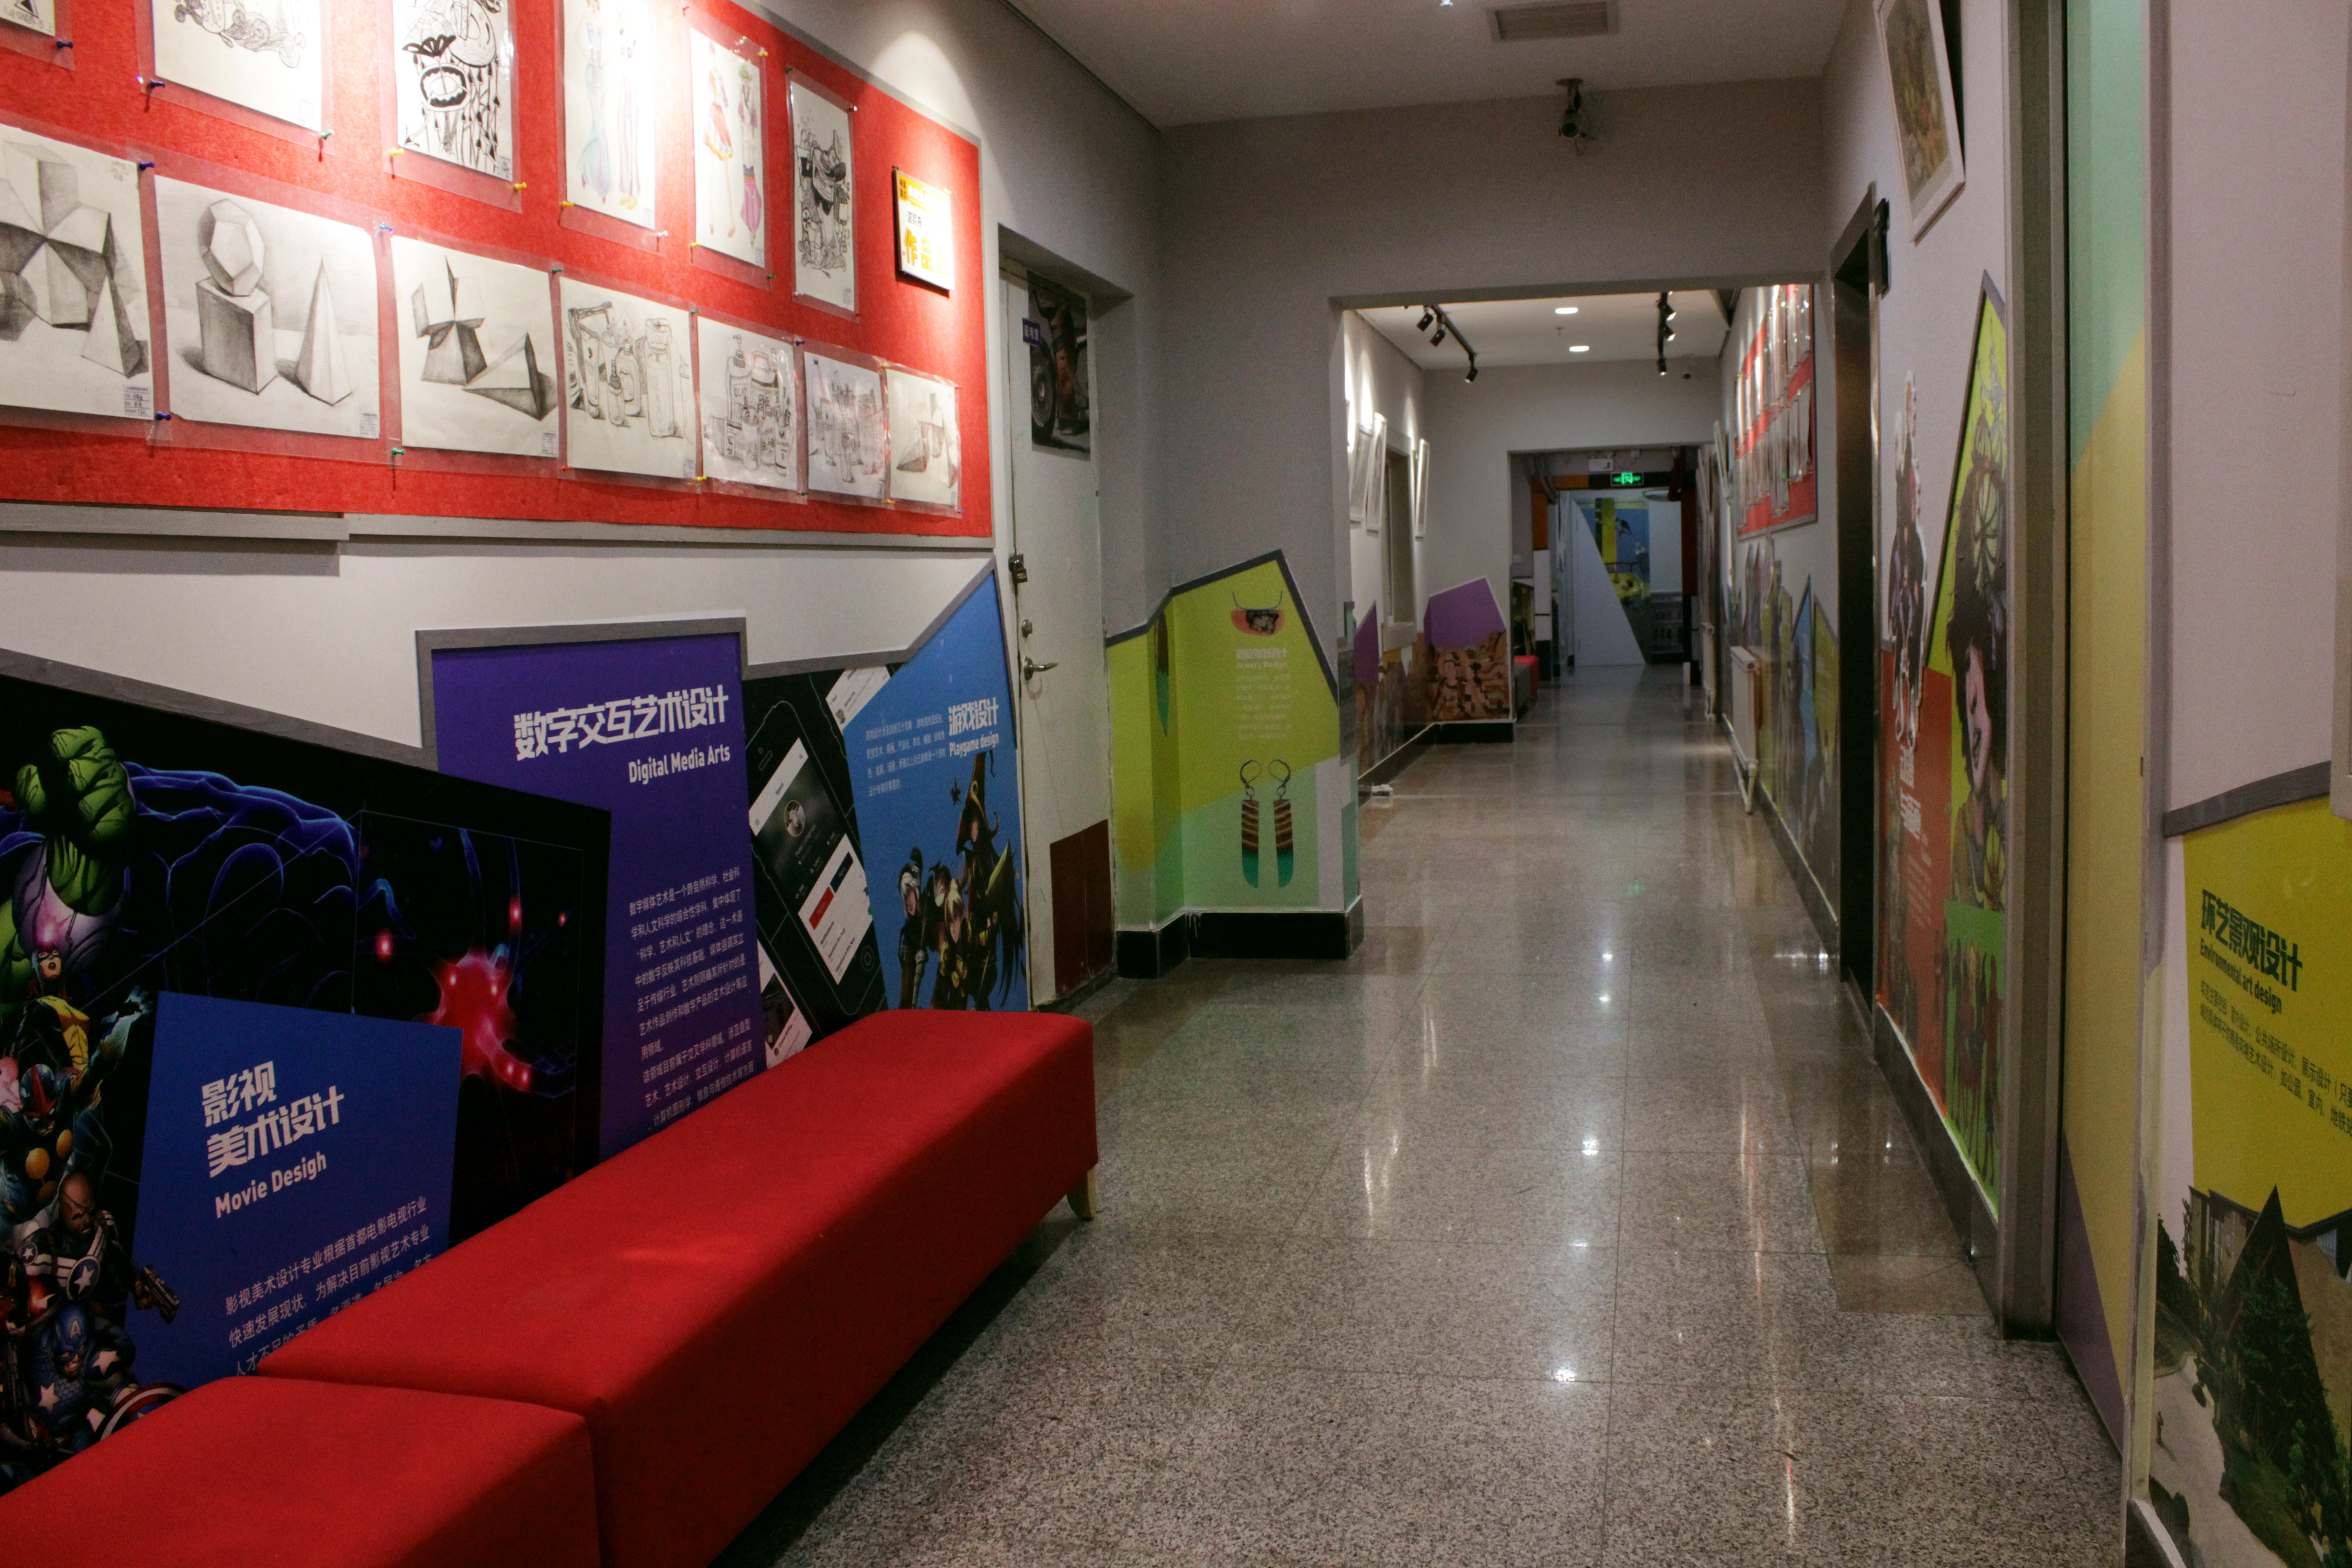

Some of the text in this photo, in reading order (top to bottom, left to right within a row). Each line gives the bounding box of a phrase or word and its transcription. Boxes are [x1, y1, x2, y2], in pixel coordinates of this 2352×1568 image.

[514, 684, 729, 761] 数字交互艺术设计
[948, 697, 999, 736] 游戏设计
[949, 739, 979, 758] Playgame
[980, 731, 999, 748] design
[628, 744, 730, 784] Digital Media Arts
[2201, 888, 2303, 991] 环艺景观设计
[2243, 975, 2253, 996] art
[2254, 980, 2282, 1014] design
[201, 1060, 277, 1127] 影视
[207, 1085, 344, 1178] 美术设计
[215, 1151, 327, 1219] Movie Desigh
[225, 1196, 427, 1315] 影视美术设计专业根据首都电影电视行业
